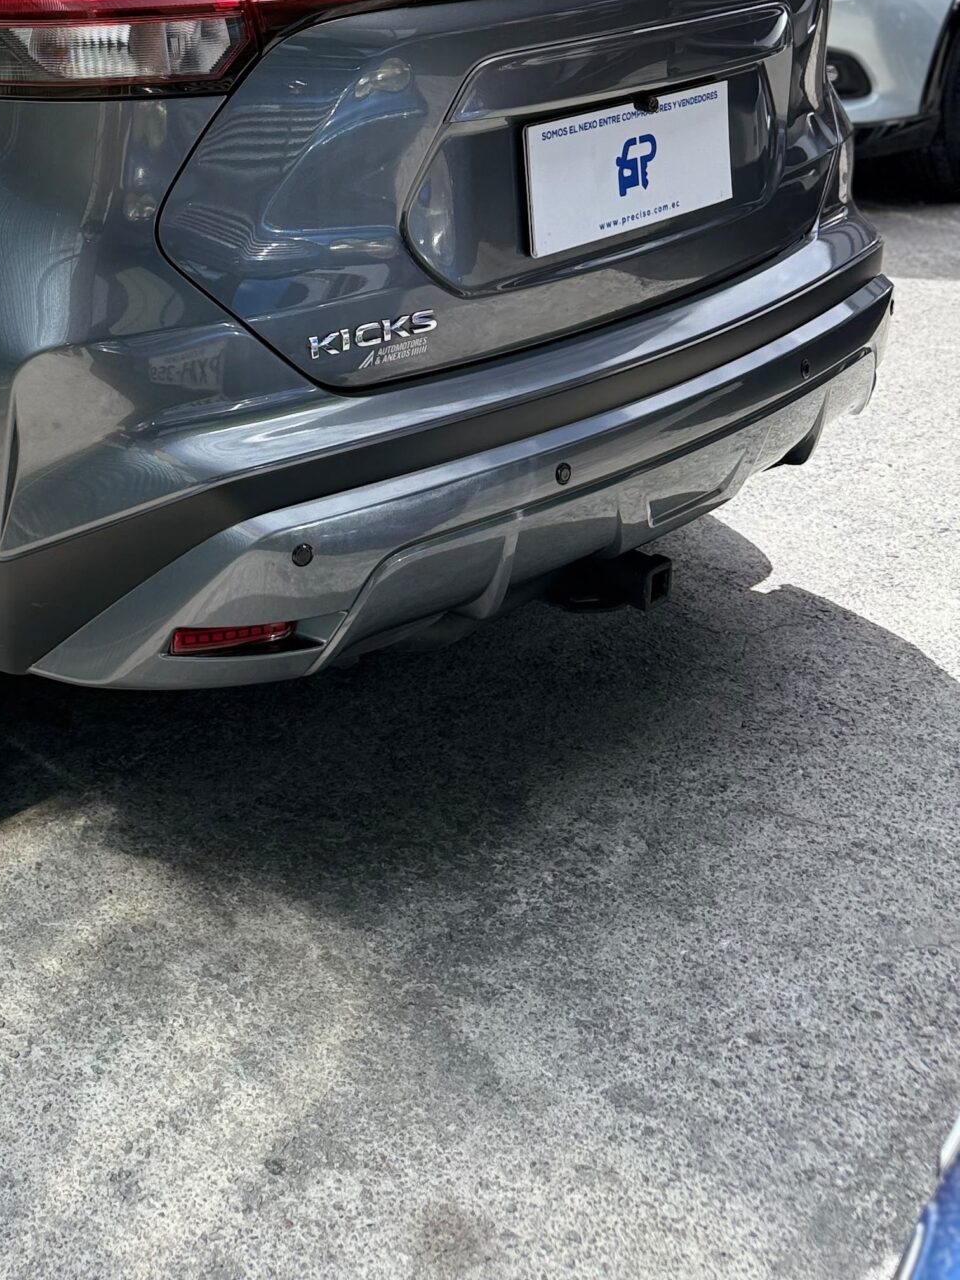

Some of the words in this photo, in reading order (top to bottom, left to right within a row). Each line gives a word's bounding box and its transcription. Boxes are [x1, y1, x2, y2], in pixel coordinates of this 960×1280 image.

[541, 126, 568, 141] SOMOS
[569, 125, 578, 135] EL
[579, 120, 598, 132] NEXO
[599, 114, 621, 127] ENTRE
[673, 101, 678, 109] Y
[678, 90, 718, 108] VENDEDORES
[599, 200, 680, 230] www.preciso.com.ec
[309, 309, 438, 359] KICKS
[377, 336, 429, 356] AUTOMOTORES
[382, 348, 411, 364] ANEXOS
